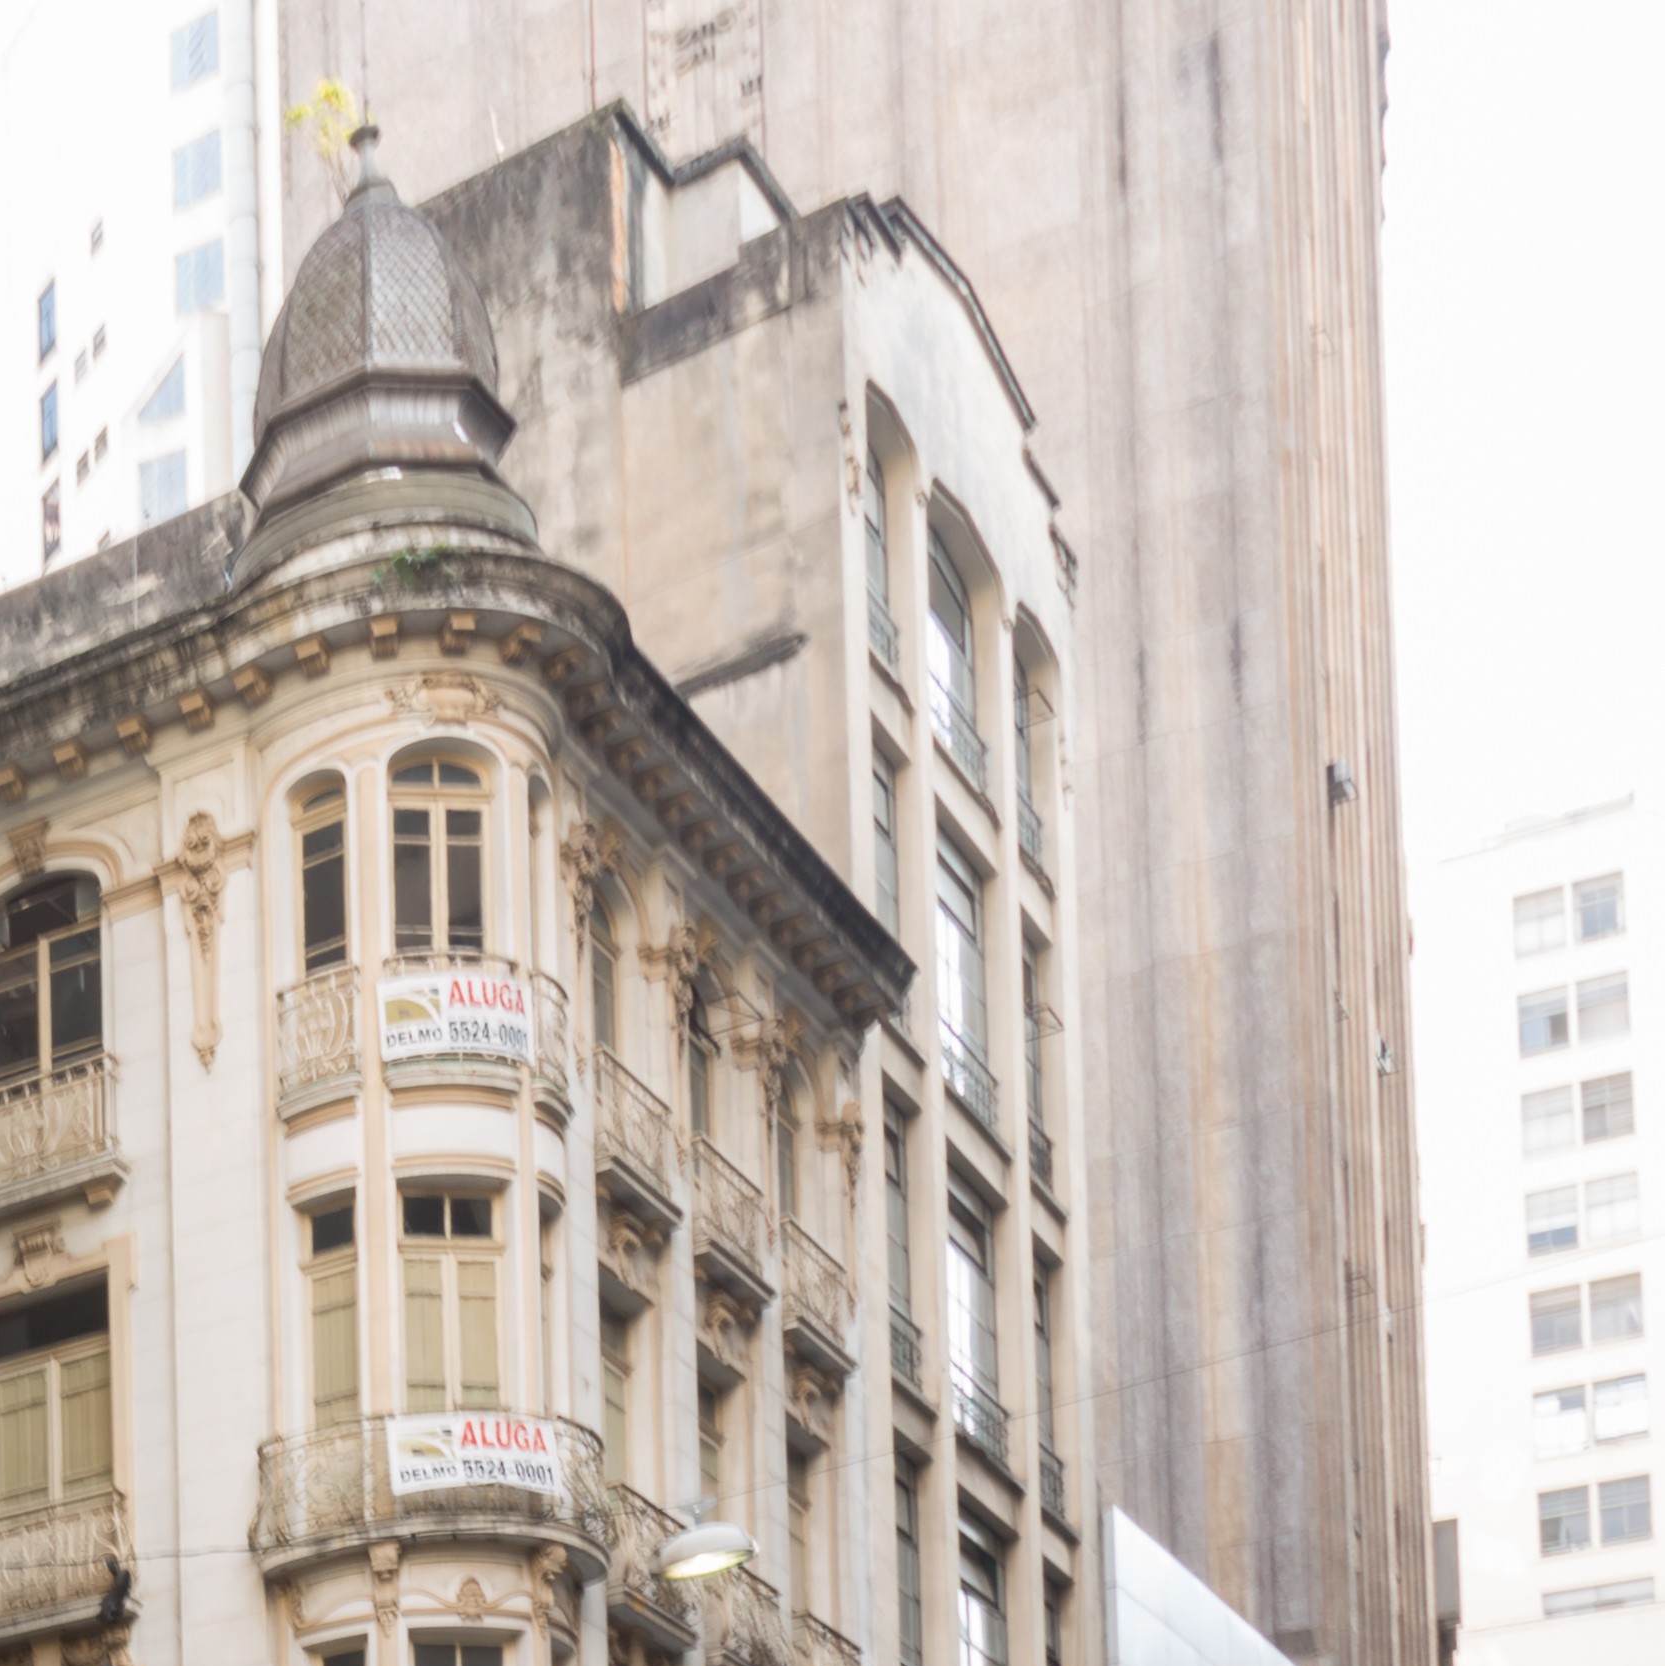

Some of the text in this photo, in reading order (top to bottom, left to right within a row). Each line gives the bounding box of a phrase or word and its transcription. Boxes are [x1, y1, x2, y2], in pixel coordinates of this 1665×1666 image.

[448, 978, 526, 1016] ALUGA
[386, 1020, 529, 1052] DELMO 5524-0001
[461, 1419, 549, 1455] ALUGA
[400, 1459, 556, 1487] DELMO 5524-0001
